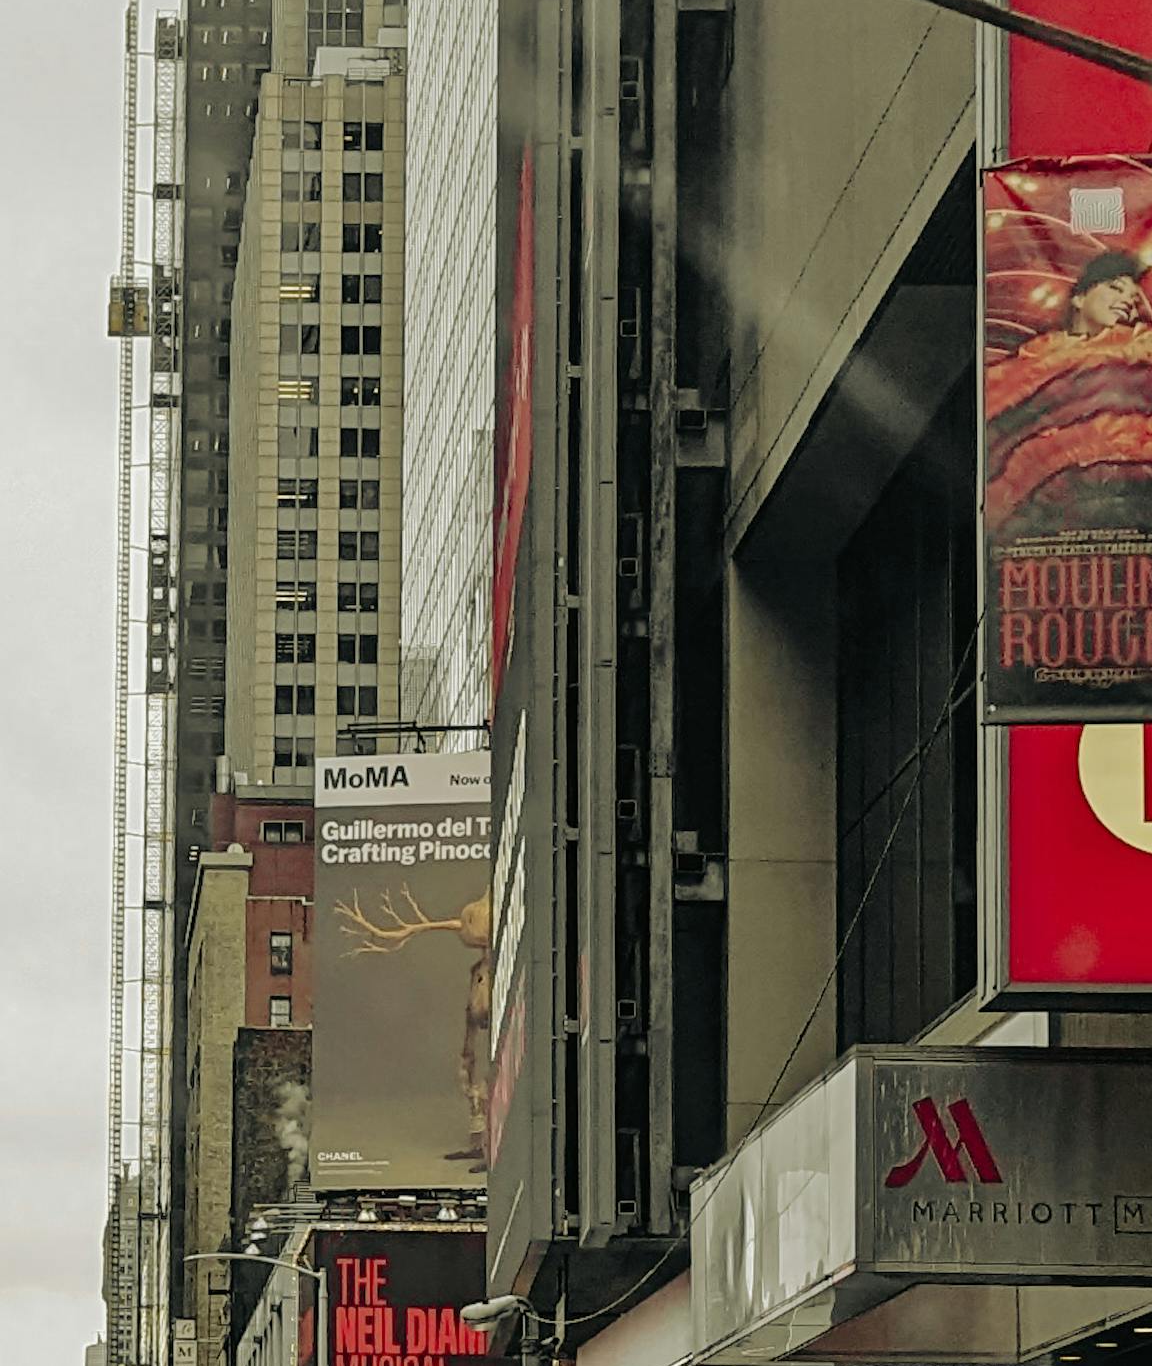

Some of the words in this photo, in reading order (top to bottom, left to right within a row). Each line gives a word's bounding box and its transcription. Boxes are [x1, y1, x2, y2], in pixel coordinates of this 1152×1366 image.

[323, 766, 409, 790] MoMA
[449, 774, 480, 786] Now
[321, 818, 434, 841] Guillermo
[436, 817, 473, 838] del
[475, 816, 491, 836] T
[321, 842, 416, 865] Crafting
[317, 1151, 363, 1161] CHANEL
[912, 1201, 1102, 1225] MARRIOTT
[337, 1258, 387, 1305] THE
[336, 1306, 400, 1354] NEIL
